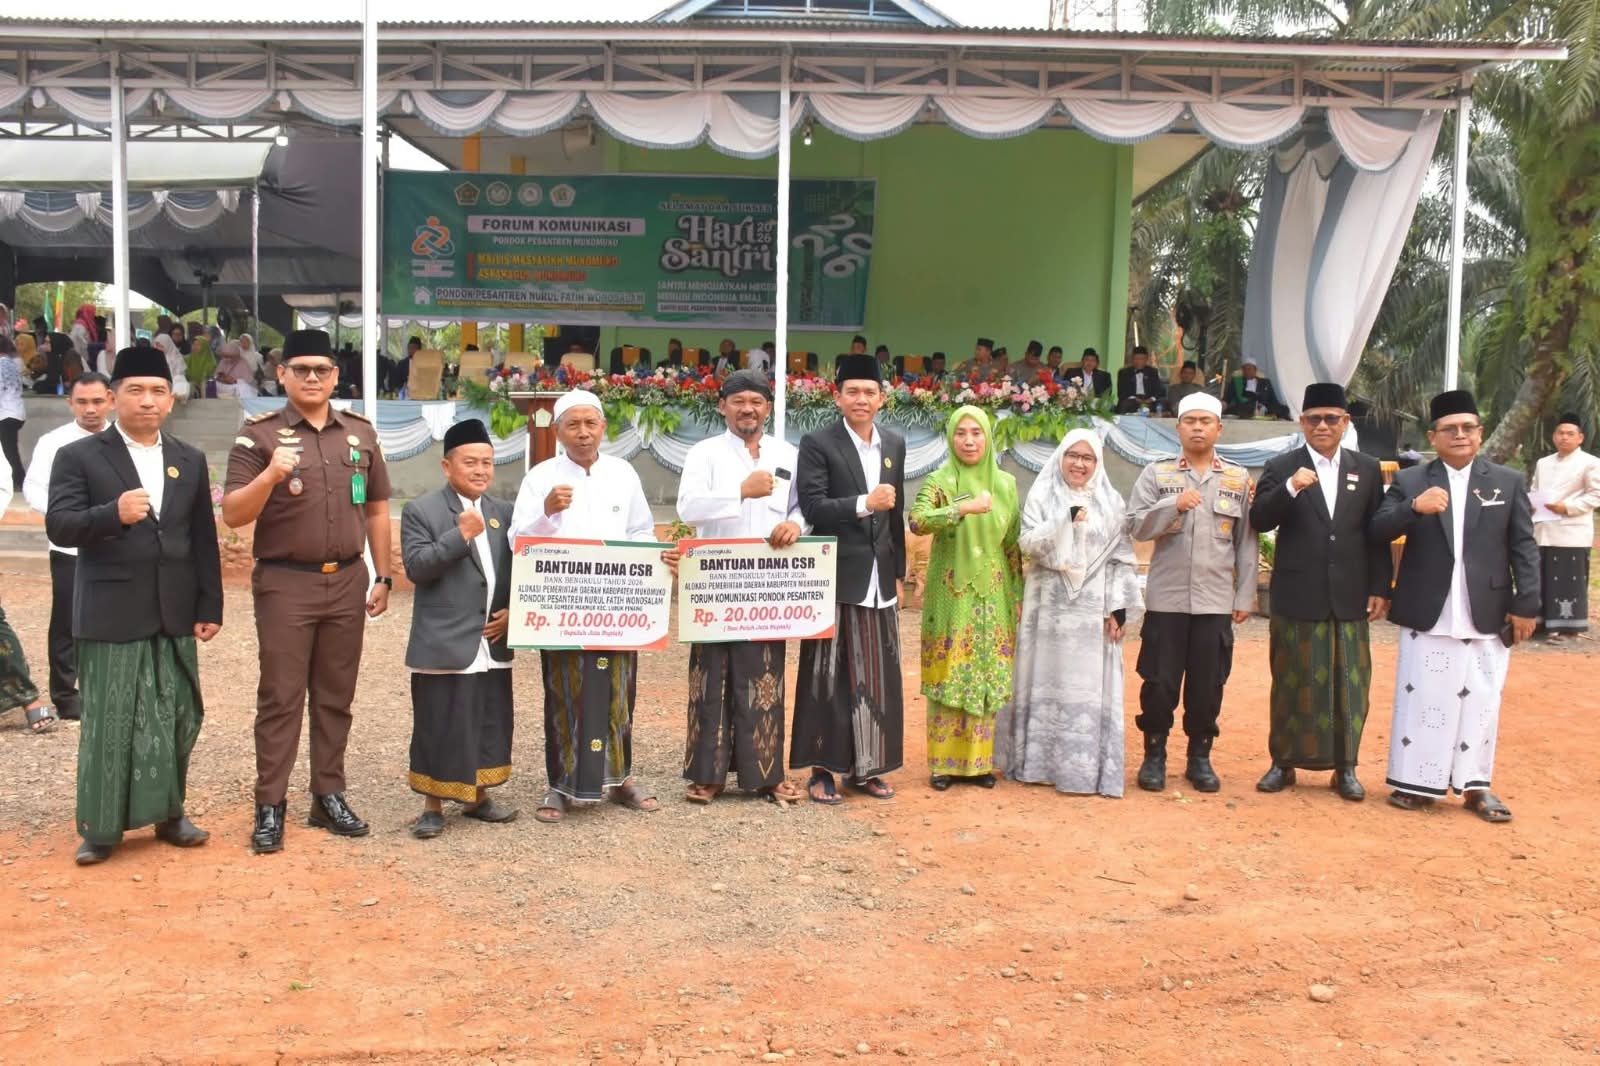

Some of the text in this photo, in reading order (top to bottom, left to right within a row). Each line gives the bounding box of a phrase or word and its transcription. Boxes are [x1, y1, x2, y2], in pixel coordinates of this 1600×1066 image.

[482, 219, 631, 232] FORUM KOMUNIKASI
[678, 215, 758, 249] Hari
[757, 222, 772, 232] 20
[494, 236, 618, 247] PONDOK PESANTREN MUKOMUKO
[566, 256, 619, 266] MUKOMUKO
[661, 238, 774, 276] Santri
[437, 288, 472, 299] PONDOK
[475, 289, 527, 301] PESANTREN
[529, 290, 558, 302] NURUL
[560, 292, 584, 302] FATIH
[1218, 490, 1241, 501] POLRI
[535, 560, 653, 576] BANTUAN DANA CSR
[700, 557, 815, 570] BANTUAN DANA CSR
[543, 585, 578, 594] PEMERINTAH
[580, 586, 601, 594] DAERAH
[603, 587, 633, 595] KABUPATEN
[635, 587, 666, 596] MUKOMUKO
[519, 594, 663, 605] PONDOK PESANTREN NURUL FATIH WONOSALAM
[690, 591, 824, 604] FORUM KOMUNIKASI PONDOK PESANTREN
[525, 612, 656, 630] Rp. 10.000.000,-
[693, 605, 822, 627] Rp. 20.000.000,-
